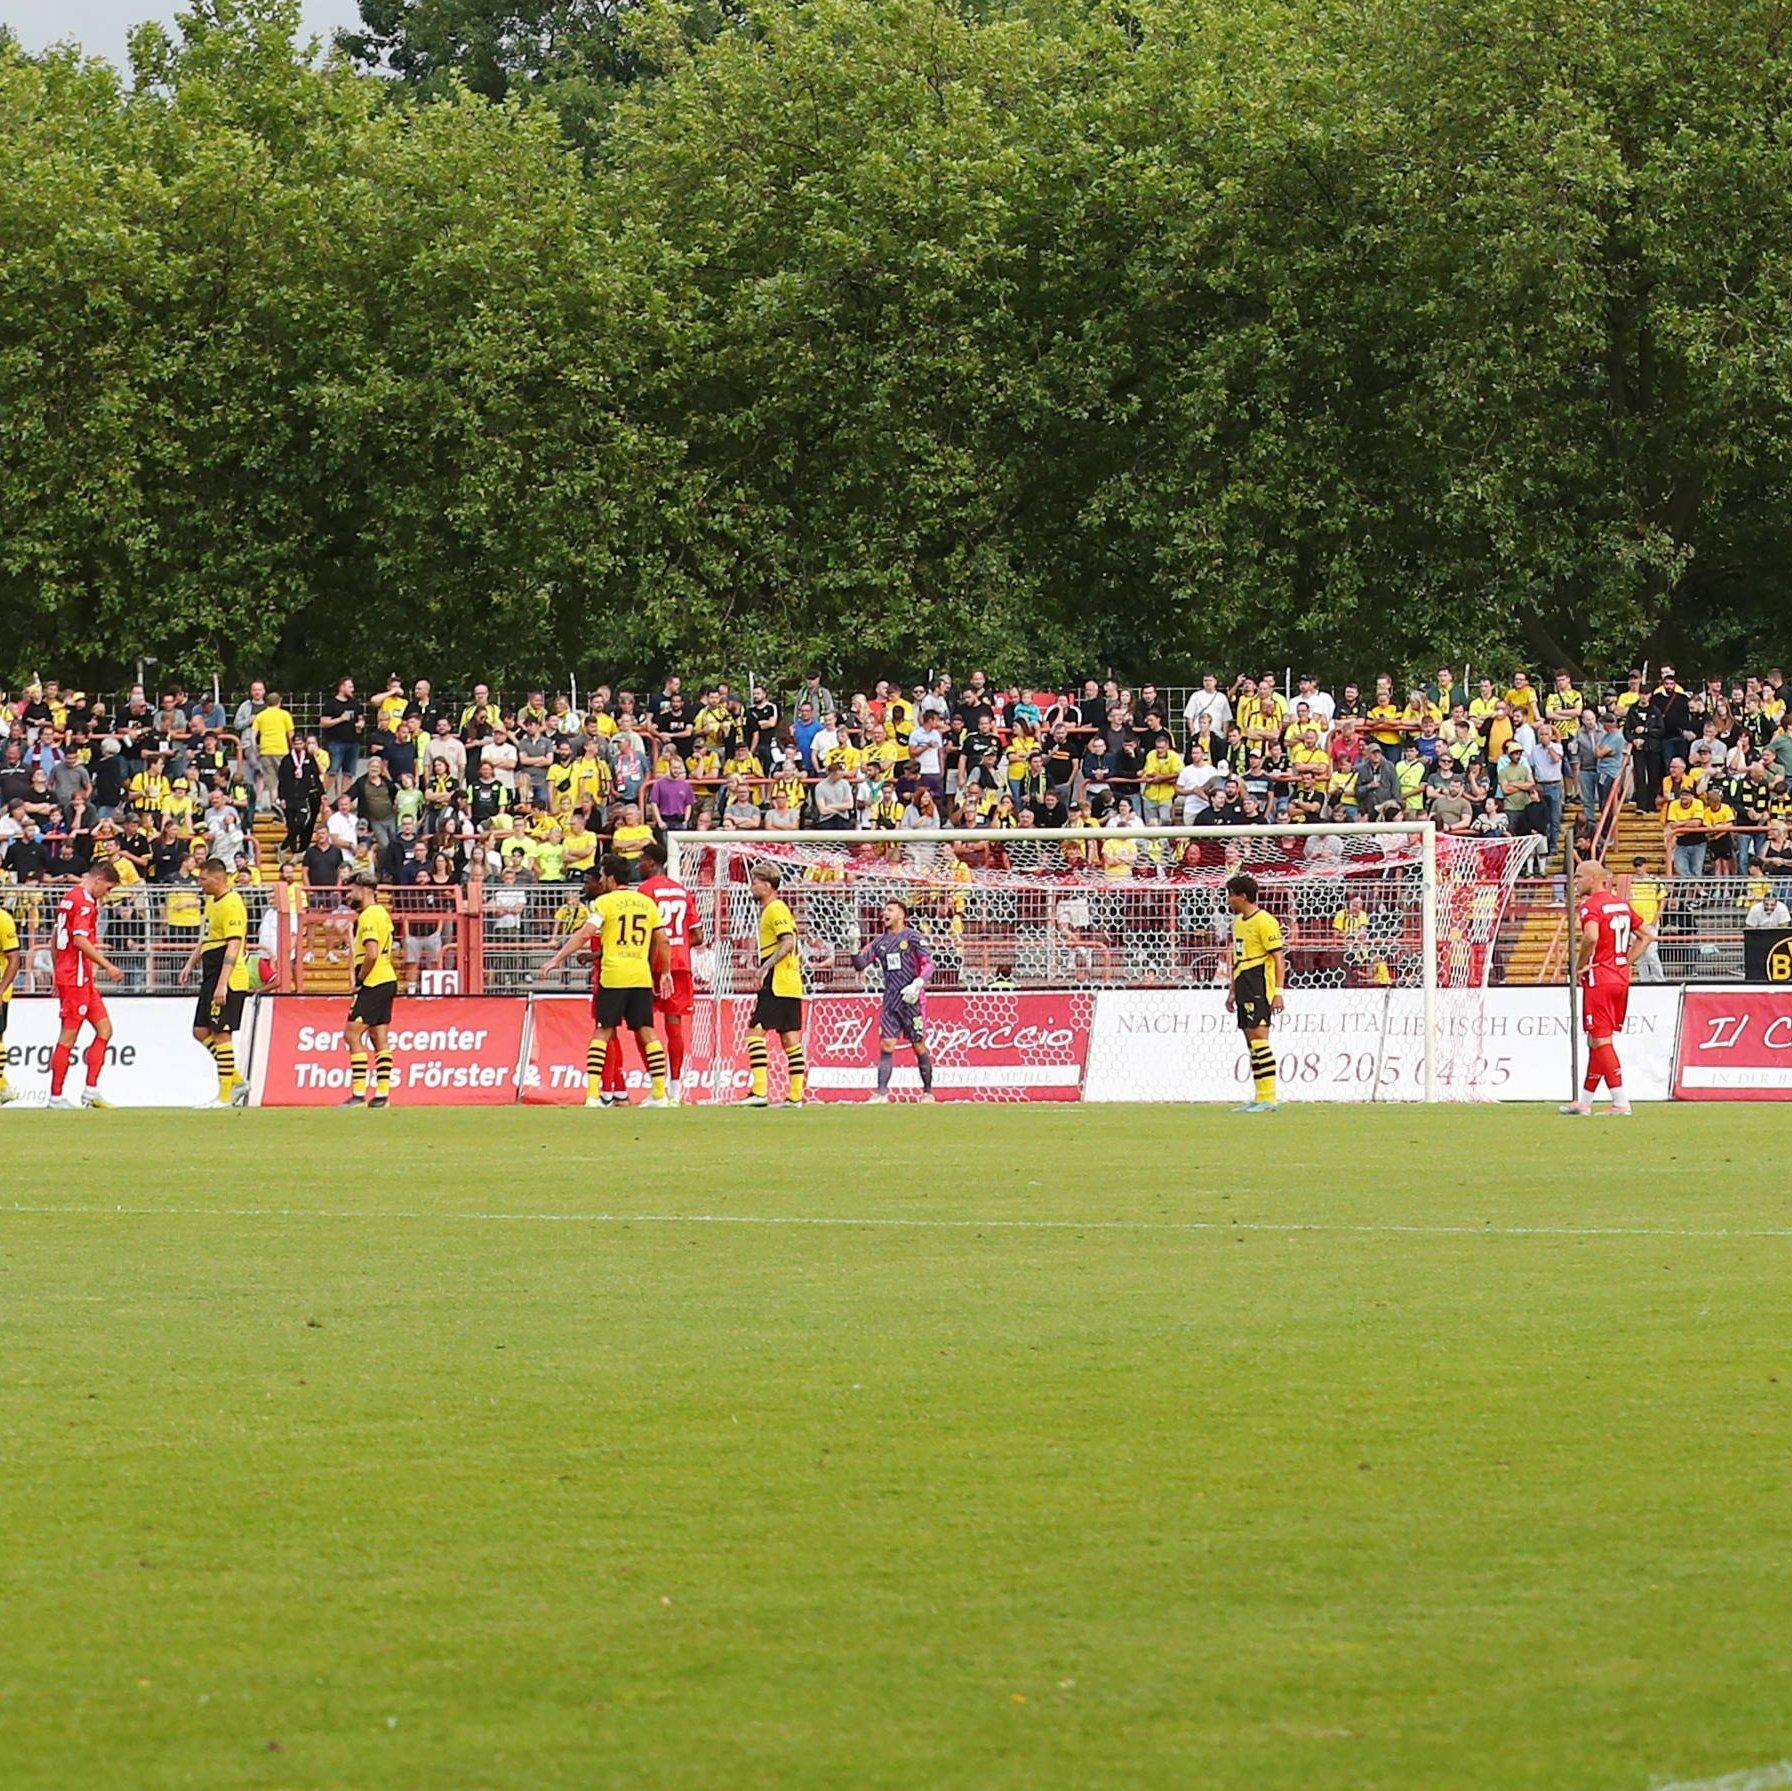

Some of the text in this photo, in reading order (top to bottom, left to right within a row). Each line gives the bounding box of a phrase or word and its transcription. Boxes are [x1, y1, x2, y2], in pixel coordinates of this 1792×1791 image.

[616, 914, 647, 947] 15
[424, 973, 455, 995] 16
[893, 1016, 1074, 1059] rpaccio
[1116, 1013, 1190, 1034] NACH
[1200, 1013, 1241, 1034] DE
[1517, 1015, 1659, 1037] GENEN
[297, 1026, 488, 1052] Serecenter
[408, 1060, 509, 1089] Förster
[550, 1064, 756, 1090] Thas ausc
[1234, 1052, 1320, 1084] 008
